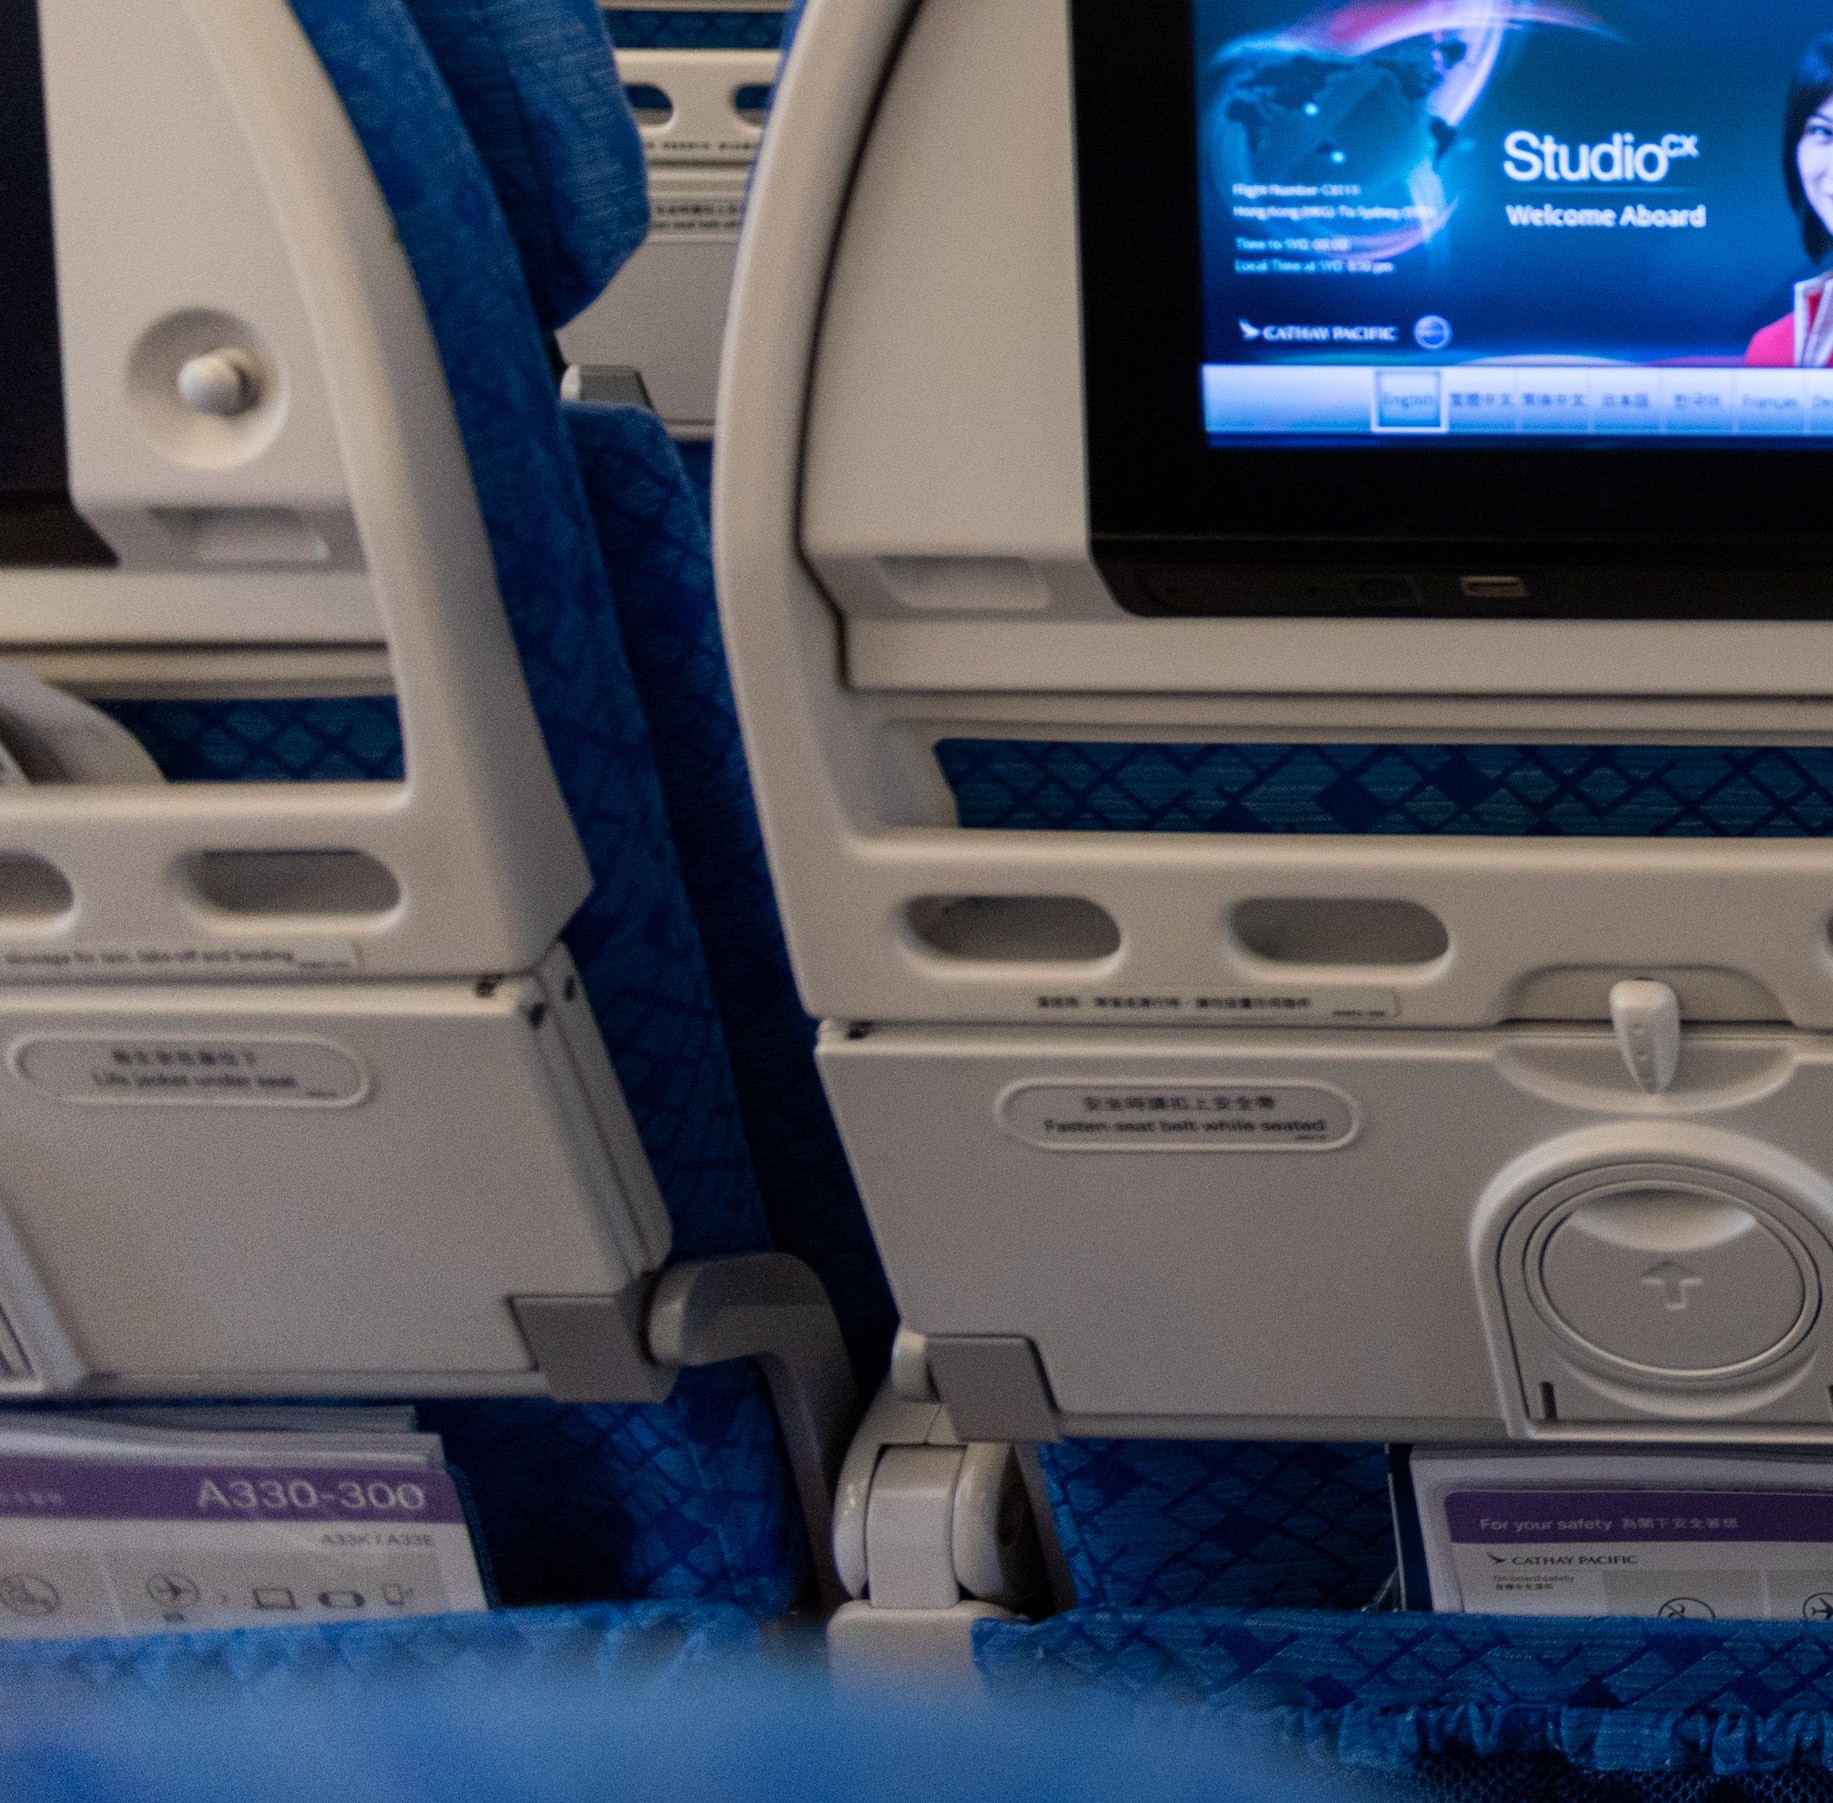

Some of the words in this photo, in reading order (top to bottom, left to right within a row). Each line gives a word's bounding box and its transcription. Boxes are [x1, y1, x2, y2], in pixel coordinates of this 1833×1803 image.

[1506, 204, 1616, 228] Welcome
[1620, 204, 1706, 228] Aboard
[1043, 1118, 1107, 1133] Fasten
[1114, 1120, 1153, 1132] seat
[1159, 1120, 1196, 1133] belt
[1203, 1119, 1255, 1133] while
[1260, 1119, 1326, 1133] seated
[198, 1480, 424, 1511] A330-300
[1480, 1518, 1508, 1530] For
[1514, 1520, 1551, 1533] your
[1556, 1518, 1613, 1532] safety
[1511, 1555, 1574, 1566] CATHAY
[1578, 1554, 1638, 1565] PACIFIC
